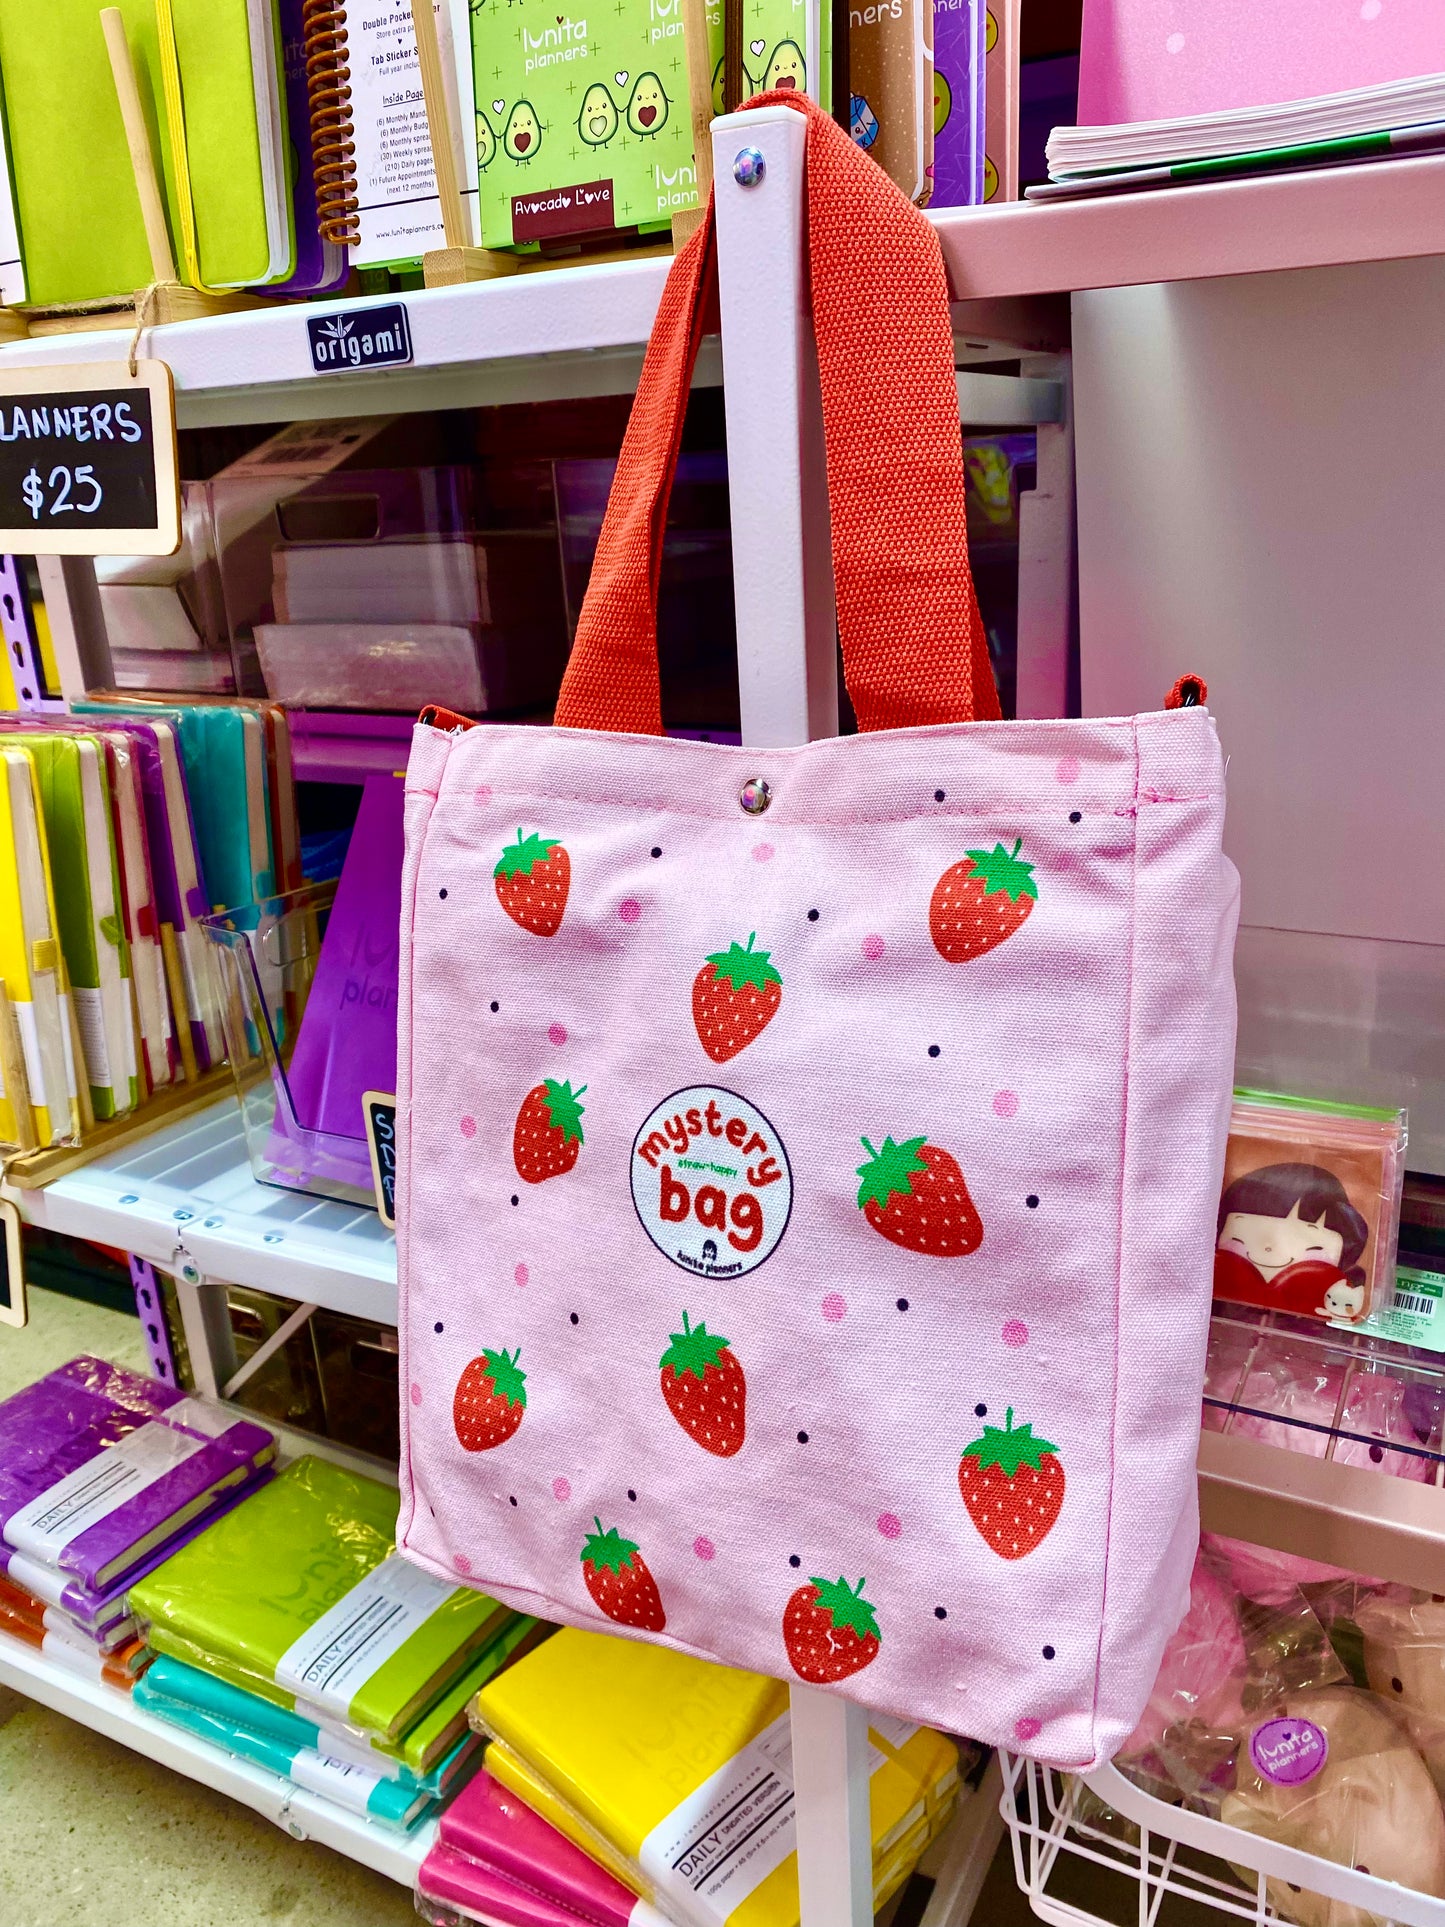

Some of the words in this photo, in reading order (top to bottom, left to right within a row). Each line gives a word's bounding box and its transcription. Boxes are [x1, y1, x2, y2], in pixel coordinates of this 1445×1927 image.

[363, 17, 387, 30] Double
[376, 30, 391, 39] Store
[392, 26, 406, 35] extra
[523, 16, 587, 53] lunita
[371, 54, 384, 65] Tab
[386, 50, 411, 62] Sticker
[525, 44, 588, 76] planners
[379, 67, 389, 76] Full
[390, 66, 402, 75] year
[382, 93, 404, 105] Inside
[386, 113, 408, 123] Monthly
[390, 125, 412, 135] Monthly
[389, 136, 412, 147] Monthly
[393, 149, 413, 158] Weekly
[401, 160, 415, 169] Daily
[416, 158, 433, 167] pages
[378, 175, 396, 184] Future
[402, 183, 410, 192] 12
[410, 180, 434, 190] months)
[315, 322, 403, 365] origami
[0, 402, 142, 443] LANNERS
[22, 465, 103, 520] $25
[637, 1100, 783, 1188] mystery
[660, 1163, 764, 1253] bag
[36, 1500, 74, 1529] DAILY
[306, 1644, 342, 1682] DAILY
[1257, 1730, 1313, 1760] lunita
[1267, 1741, 1319, 1774] planners
[679, 1832, 722, 1877] DAILY
